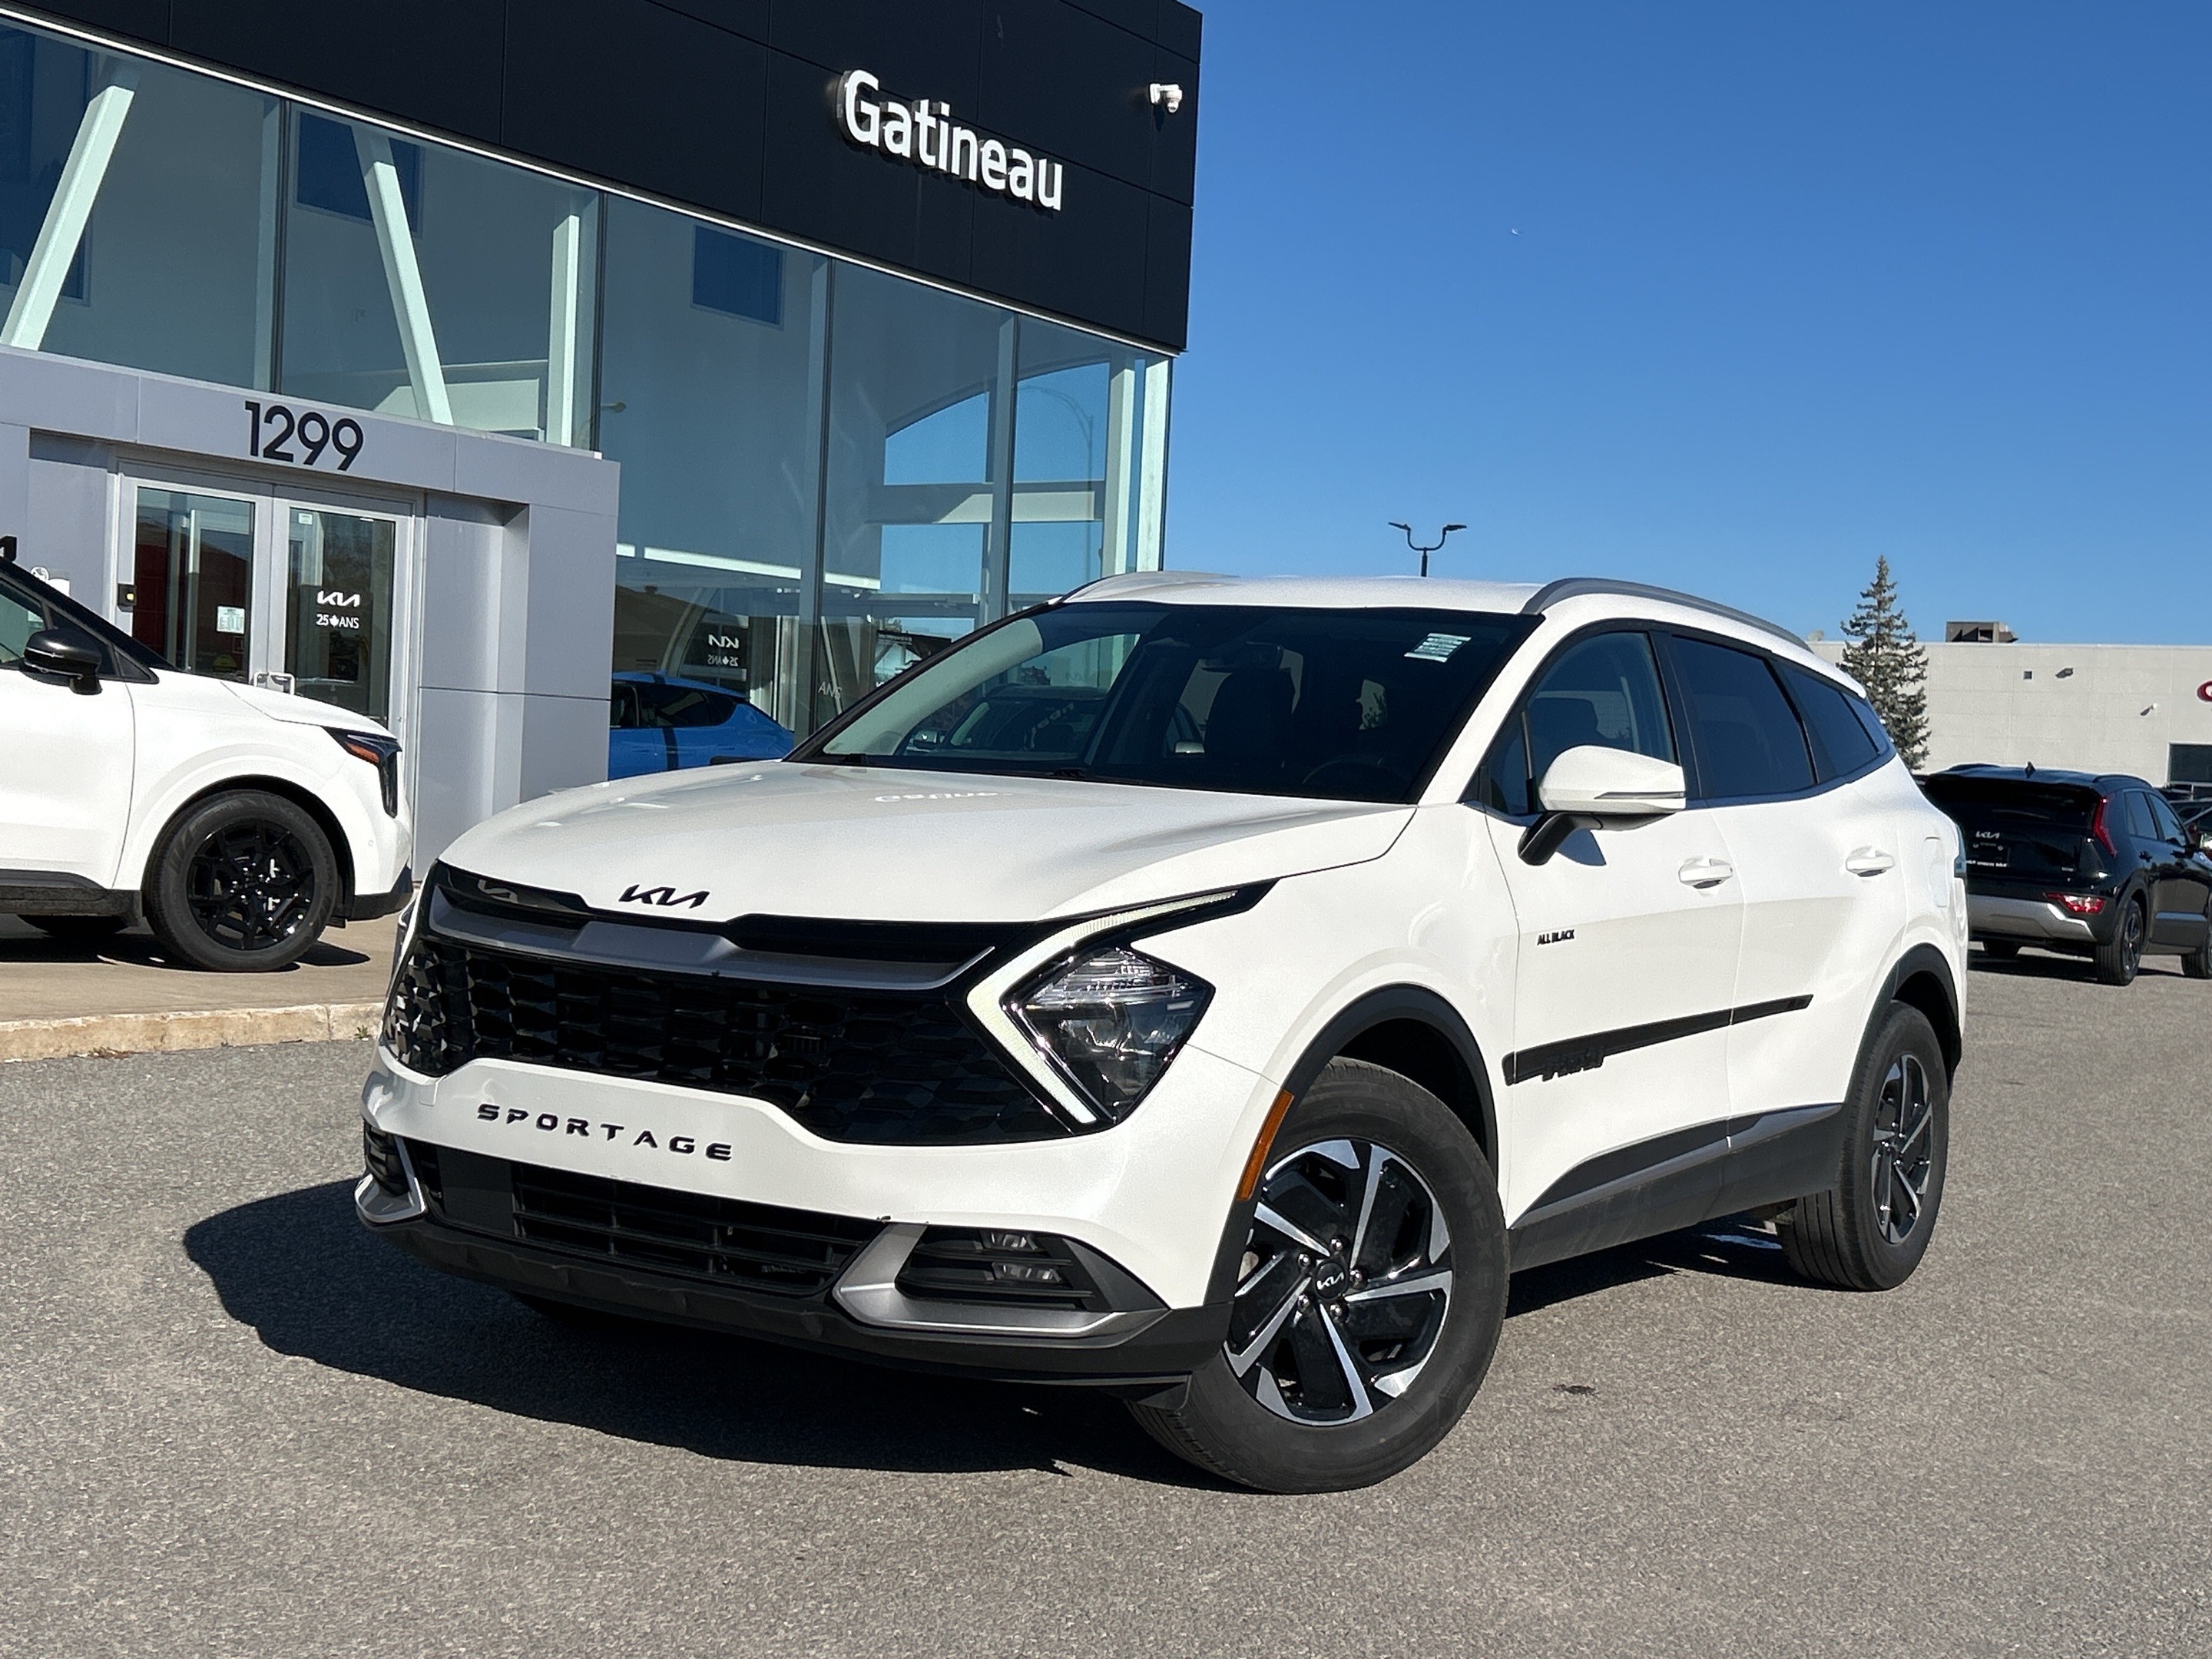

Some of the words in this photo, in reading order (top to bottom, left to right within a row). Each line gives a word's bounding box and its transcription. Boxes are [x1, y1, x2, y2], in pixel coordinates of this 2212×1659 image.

[836, 69, 1064, 211] Gatineau
[244, 400, 364, 472] 1299
[316, 590, 360, 608] KIA
[316, 613, 329, 626] 25
[339, 616, 359, 629] ANS
[618, 884, 710, 909] KIA
[476, 1104, 732, 1161] SPORTAGE
[1316, 1272, 1345, 1290] KIA
